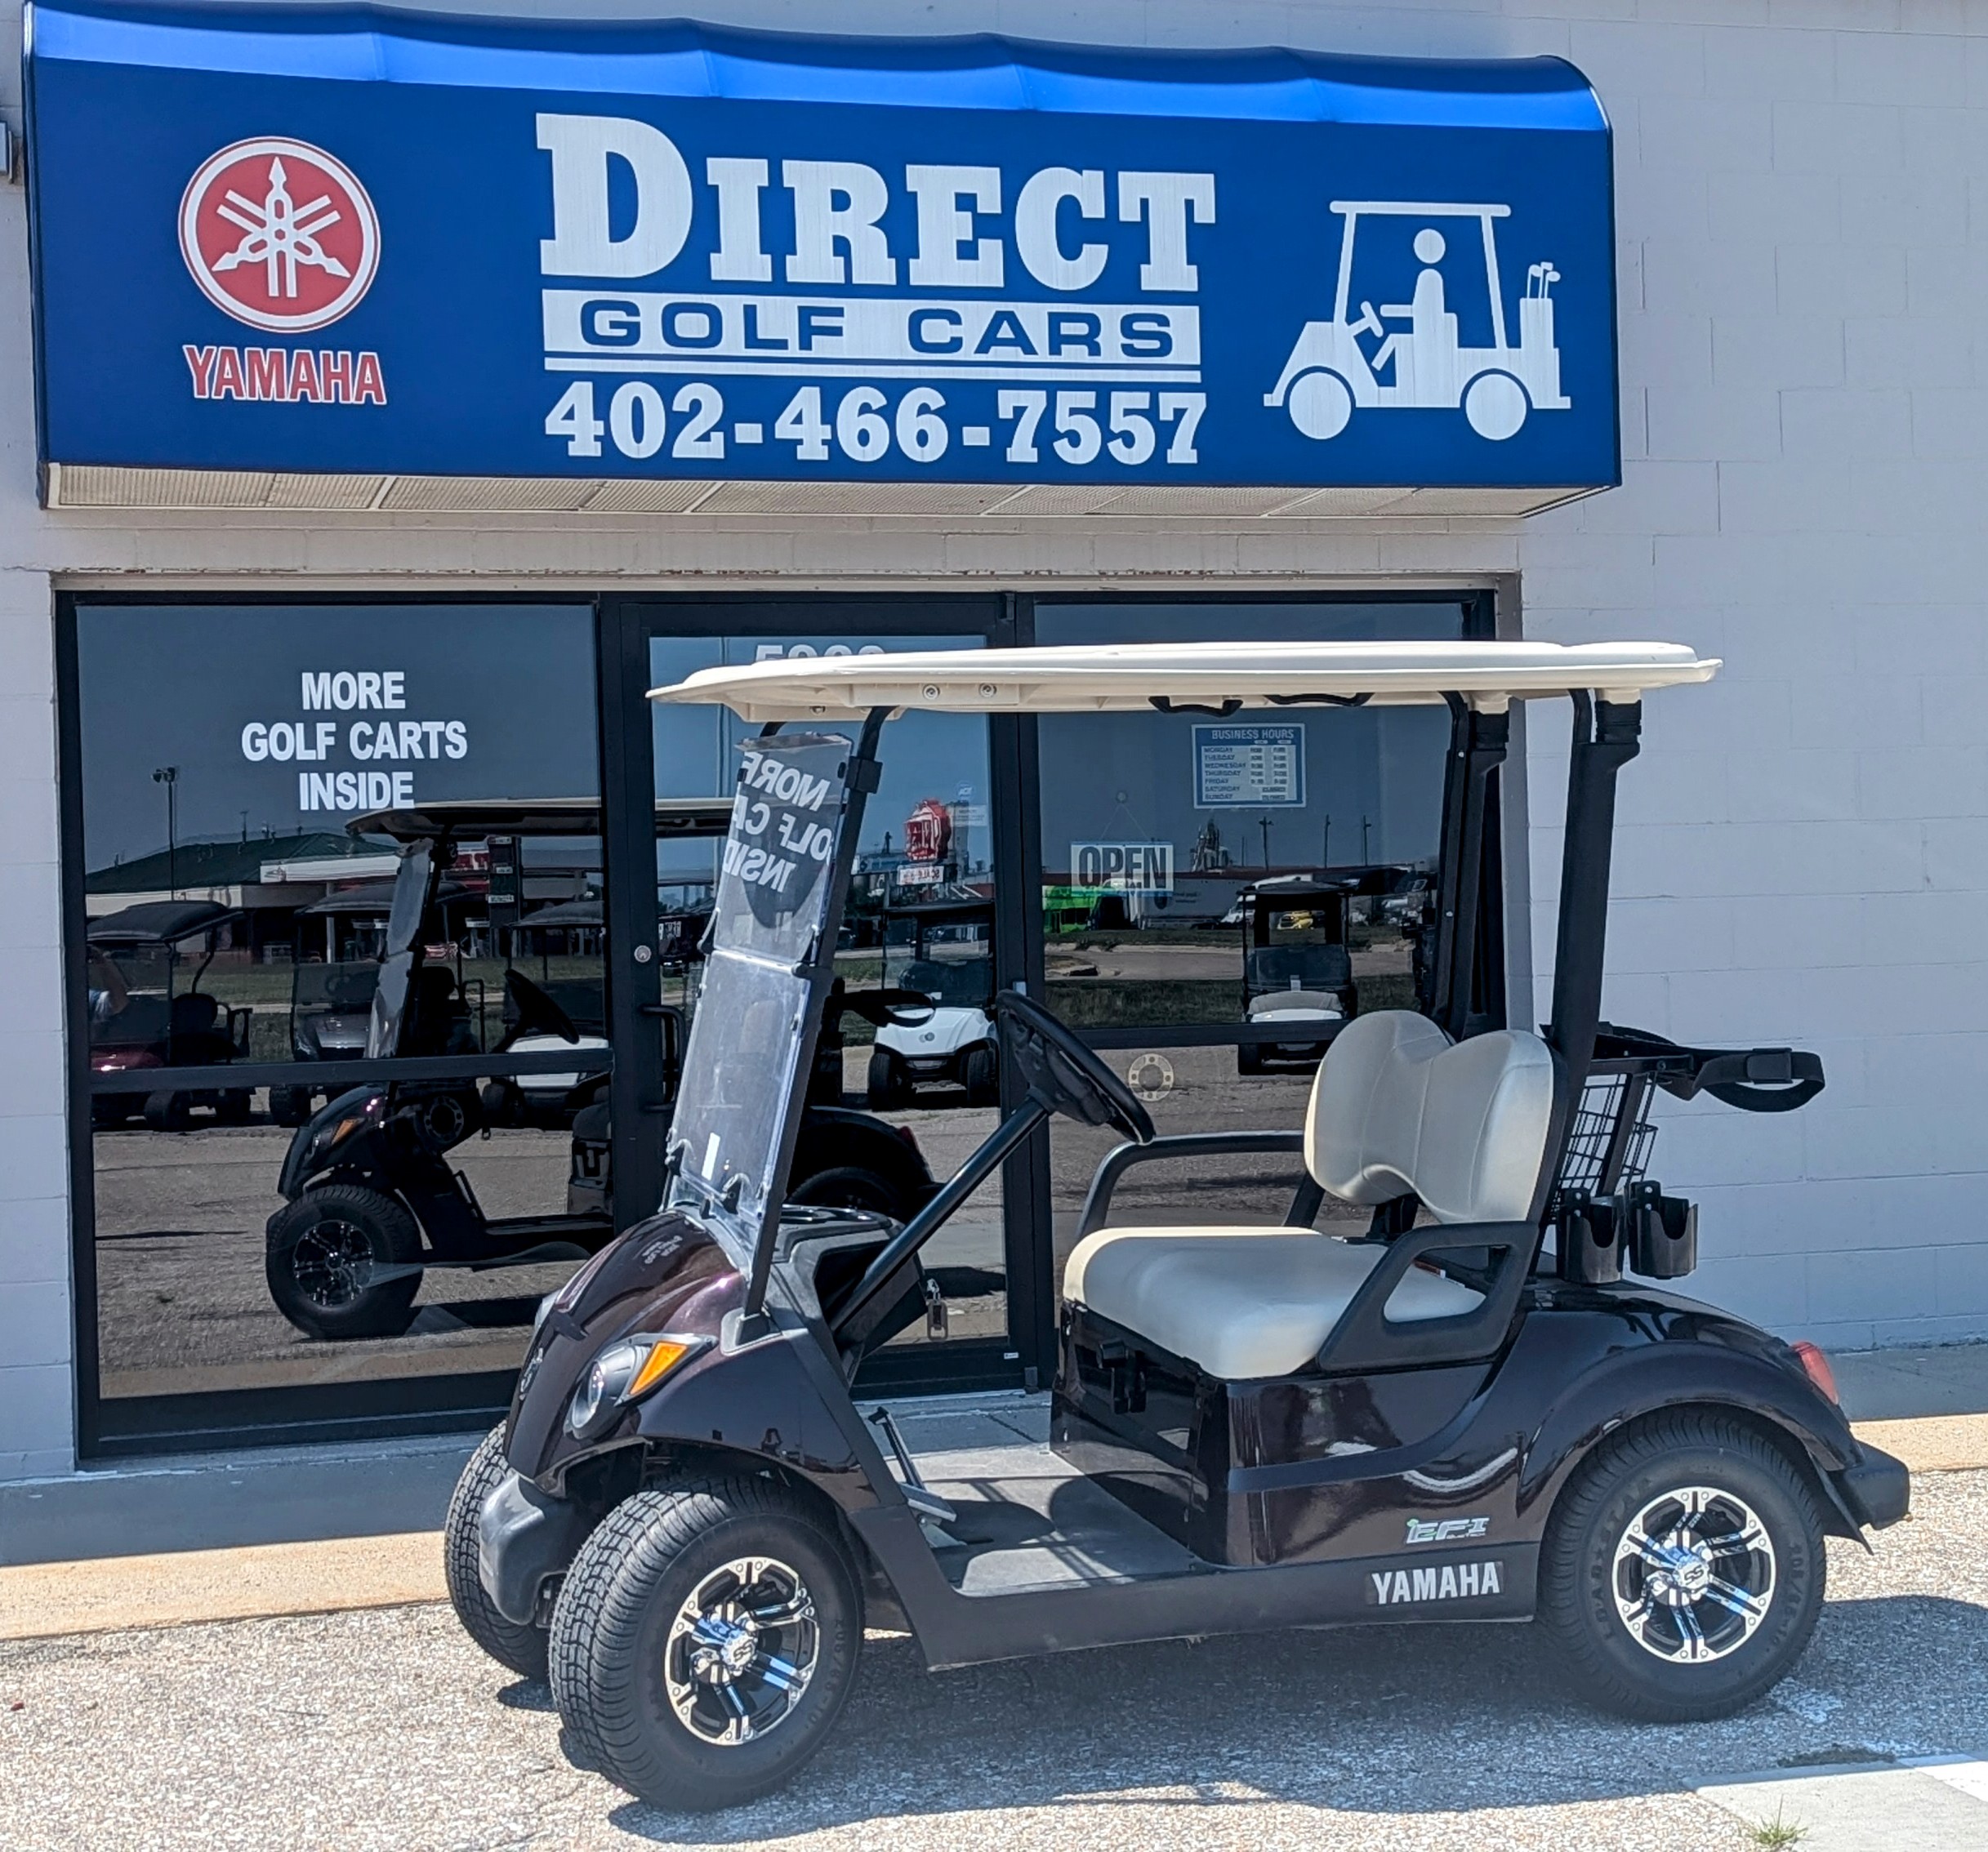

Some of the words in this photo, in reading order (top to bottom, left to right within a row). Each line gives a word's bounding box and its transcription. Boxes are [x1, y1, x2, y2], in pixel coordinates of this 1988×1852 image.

[536, 113, 1216, 292] DIRECT
[579, 299, 845, 351] GOLF
[907, 308, 1174, 358] CARS
[182, 345, 387, 405] YAMAHA
[545, 381, 1207, 465] 402-466-7557
[301, 671, 406, 710] MORE
[242, 722, 337, 761] GOLF
[349, 720, 468, 759] CARTS
[1211, 729, 1259, 740] BUSINESS
[1262, 728, 1295, 739] HOURS
[299, 771, 416, 811] INSIDE
[1078, 846, 1167, 888] OPEN
[1371, 1561, 1500, 1605] YAMAHA
